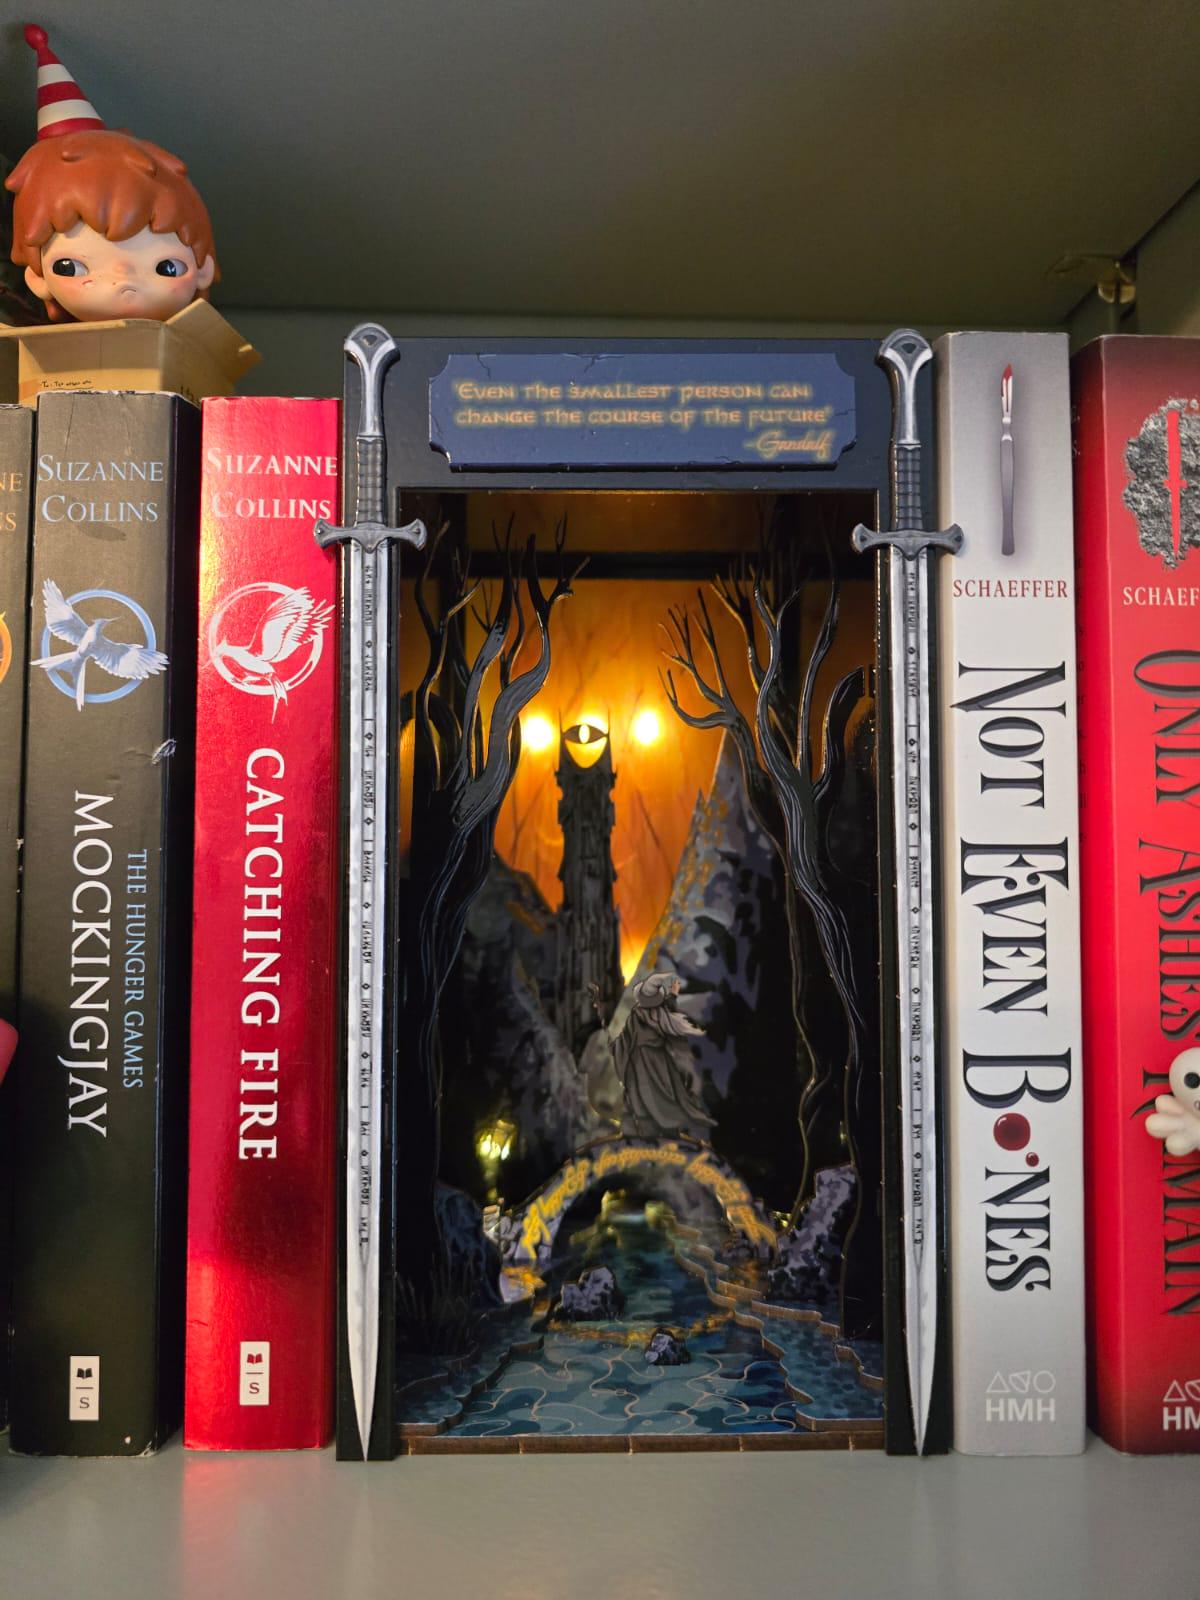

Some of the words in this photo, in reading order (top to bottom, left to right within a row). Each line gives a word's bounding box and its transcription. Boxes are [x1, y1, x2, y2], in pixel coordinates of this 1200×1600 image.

[37, 454, 164, 483] SUZANNE
[205, 449, 338, 477] SUZANNE
[41, 495, 159, 523] COLLINS
[211, 491, 332, 520] COLLINS
[953, 579, 1068, 599] SCHAEFFER
[950, 660, 1067, 809] NOT
[126, 848, 147, 895] THE
[239, 747, 285, 1028] CATCHING
[960, 836, 1069, 1017] EVEN
[58, 789, 114, 1139] MOCKINGJAY
[124, 903, 146, 1006] HUNGER
[123, 1012, 145, 1090] GAMES
[238, 1048, 280, 1160] FIRE
[79, 1396, 90, 1410] S
[249, 1382, 260, 1395] S
[985, 1398, 1056, 1422] HMH
